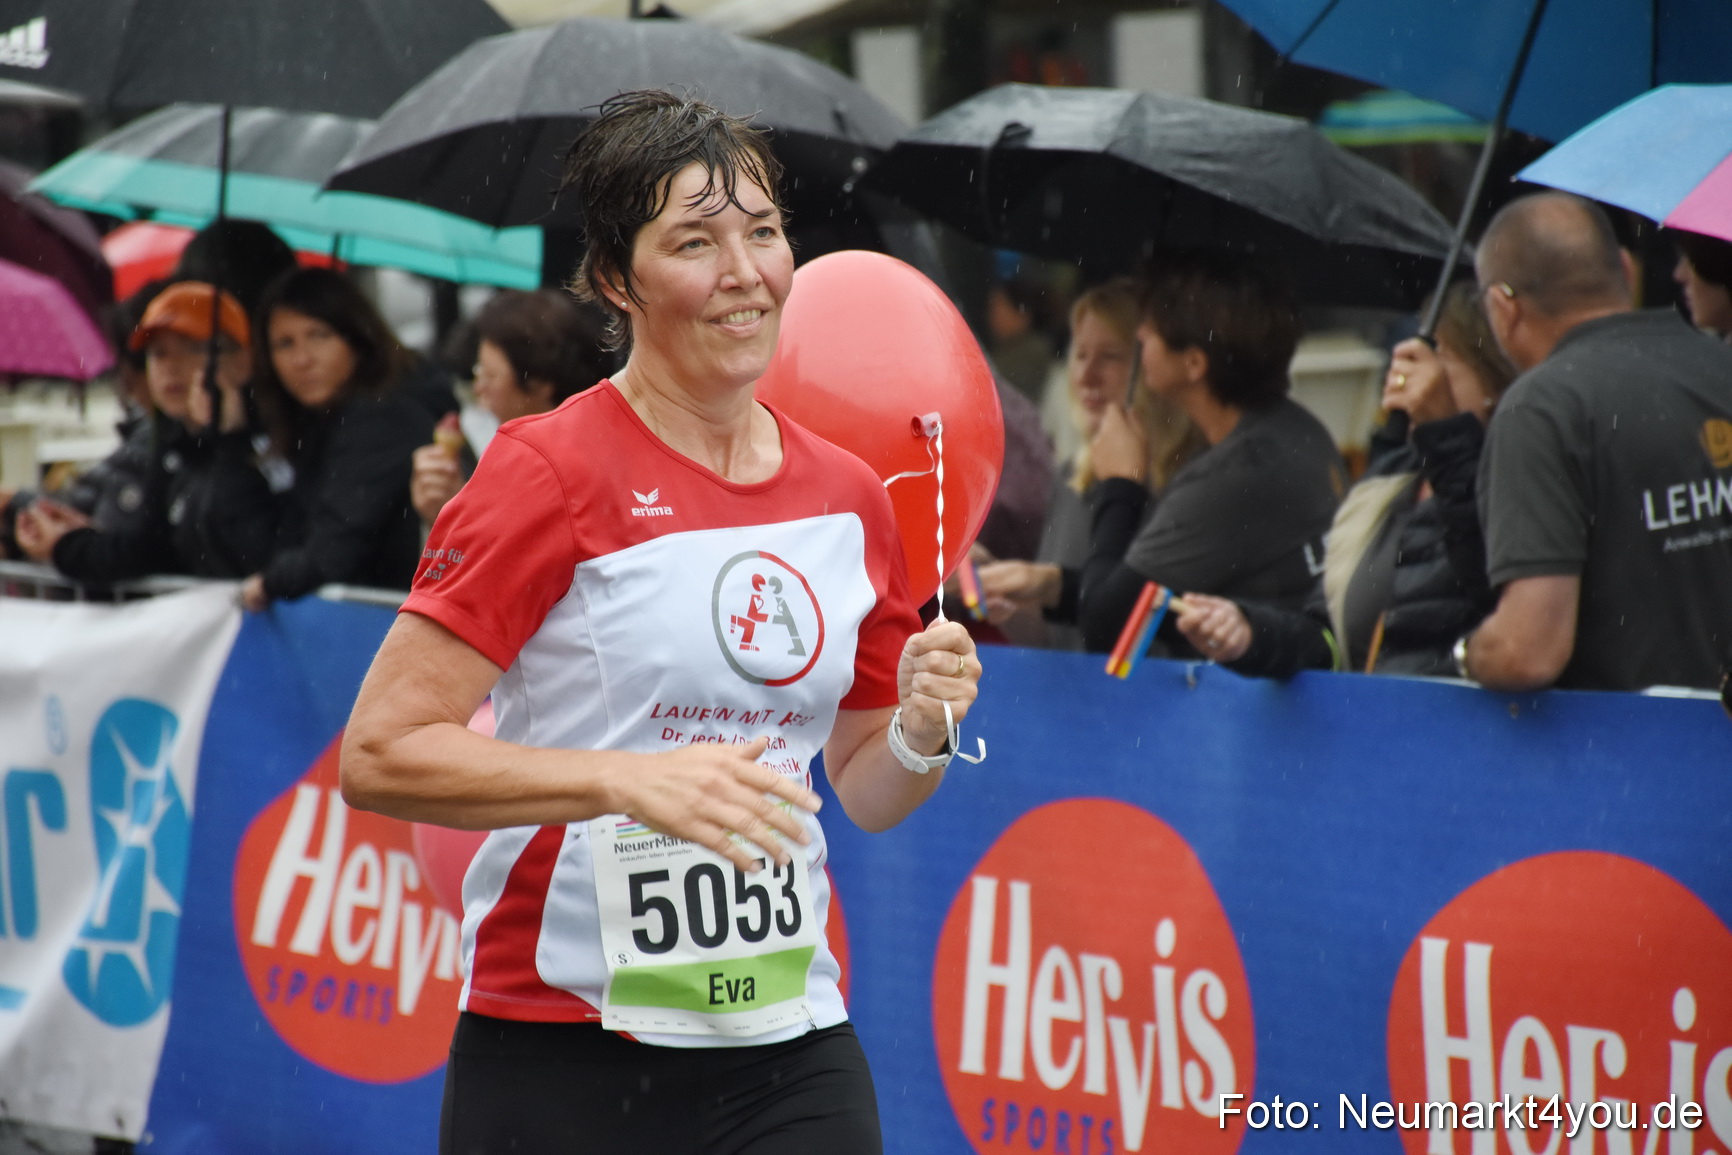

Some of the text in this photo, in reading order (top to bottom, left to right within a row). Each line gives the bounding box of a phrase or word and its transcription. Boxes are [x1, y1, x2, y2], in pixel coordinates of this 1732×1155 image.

[631, 504, 674, 517] erima
[447, 548, 465, 564] für
[738, 709, 775, 726] MIT
[661, 727, 685, 744] Dr.
[613, 836, 690, 854] NeuerMark
[252, 784, 464, 1016] Herv
[628, 853, 802, 955] 5053
[266, 965, 394, 1026] SPORTS
[708, 972, 756, 1006] Eva
[959, 875, 1237, 1152] Hervis
[981, 1098, 1114, 1155] SPORTS
